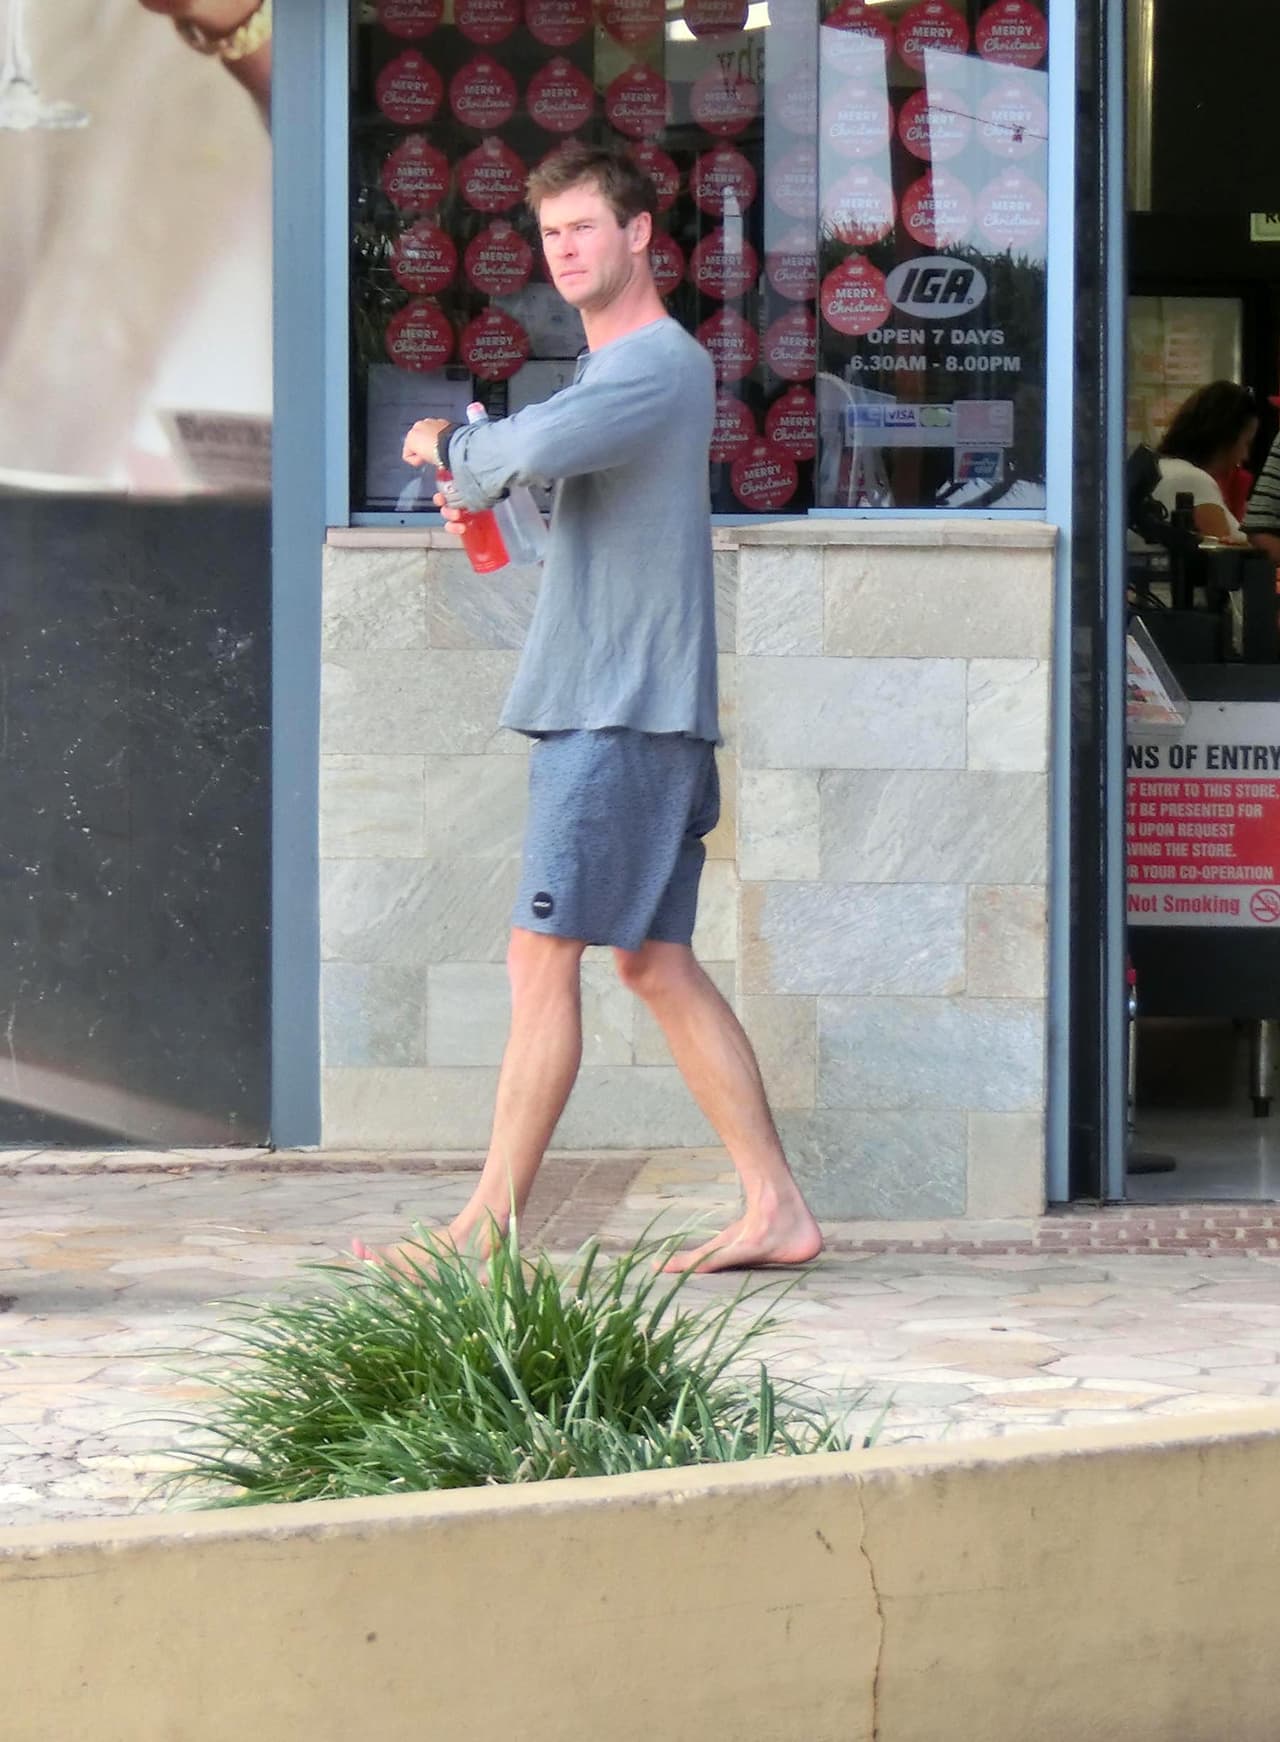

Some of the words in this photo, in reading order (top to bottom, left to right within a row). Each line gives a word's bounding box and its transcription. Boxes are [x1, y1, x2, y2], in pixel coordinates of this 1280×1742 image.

[912, 26, 954, 38] MERRY
[991, 25, 1033, 36] MERRY
[984, 36, 1042, 51] Christmas
[391, 79, 429, 92] MERRY
[464, 85, 502, 95] MERRY
[382, 90, 435, 105] Christmas
[541, 88, 578, 98] MERRY
[620, 92, 659, 102] MERRY
[456, 97, 511, 110] Christmas
[534, 99, 588, 113] Christmas
[396, 167, 436, 177] MERRY
[473, 168, 512, 179] MERRY
[390, 177, 444, 192] Christmas
[465, 178, 520, 193] Christmas
[480, 251, 518, 262] MERRY
[705, 255, 743, 265] MERRY
[397, 260, 450, 274] Christmas
[472, 262, 526, 276] Christmas
[698, 266, 751, 280] Christmas
[896, 268, 974, 304] IGA
[835, 288, 877, 299] MERRY
[828, 299, 887, 315] Christmas
[400, 328, 439, 339] MERRY
[867, 329, 925, 345] OPEN
[932, 329, 944, 345] 7
[951, 329, 1005, 345] DAYS
[393, 339, 447, 353] Christmas
[476, 336, 513, 346] MERRY
[706, 337, 744, 348] MERRY
[469, 347, 524, 361] Christmas
[850, 355, 926, 371] 6.30AM
[945, 356, 1021, 371] 8.00PM
[889, 408, 915, 420] VISA
[744, 463, 782, 480] MERRY
[740, 477, 793, 496] Christmas
[1169, 745, 1197, 769] OF
[1206, 745, 1280, 770] ENTRY
[1140, 783, 1180, 797] ENTRY
[1184, 783, 1199, 797] TO
[1203, 783, 1231, 798] THIS
[1140, 803, 1156, 816] BE
[1160, 804, 1234, 817] PRESENTED
[1238, 804, 1263, 818] FOR
[1140, 823, 1174, 836] UPON
[1178, 823, 1235, 837] REQUEST
[1165, 843, 1188, 857] THE
[1192, 843, 1237, 857] STORE.
[1143, 865, 1176, 878] YOUR
[1180, 865, 1273, 879] CO-OPERATION
[1128, 894, 1157, 913] Not
[1163, 894, 1240, 915] Smoking
